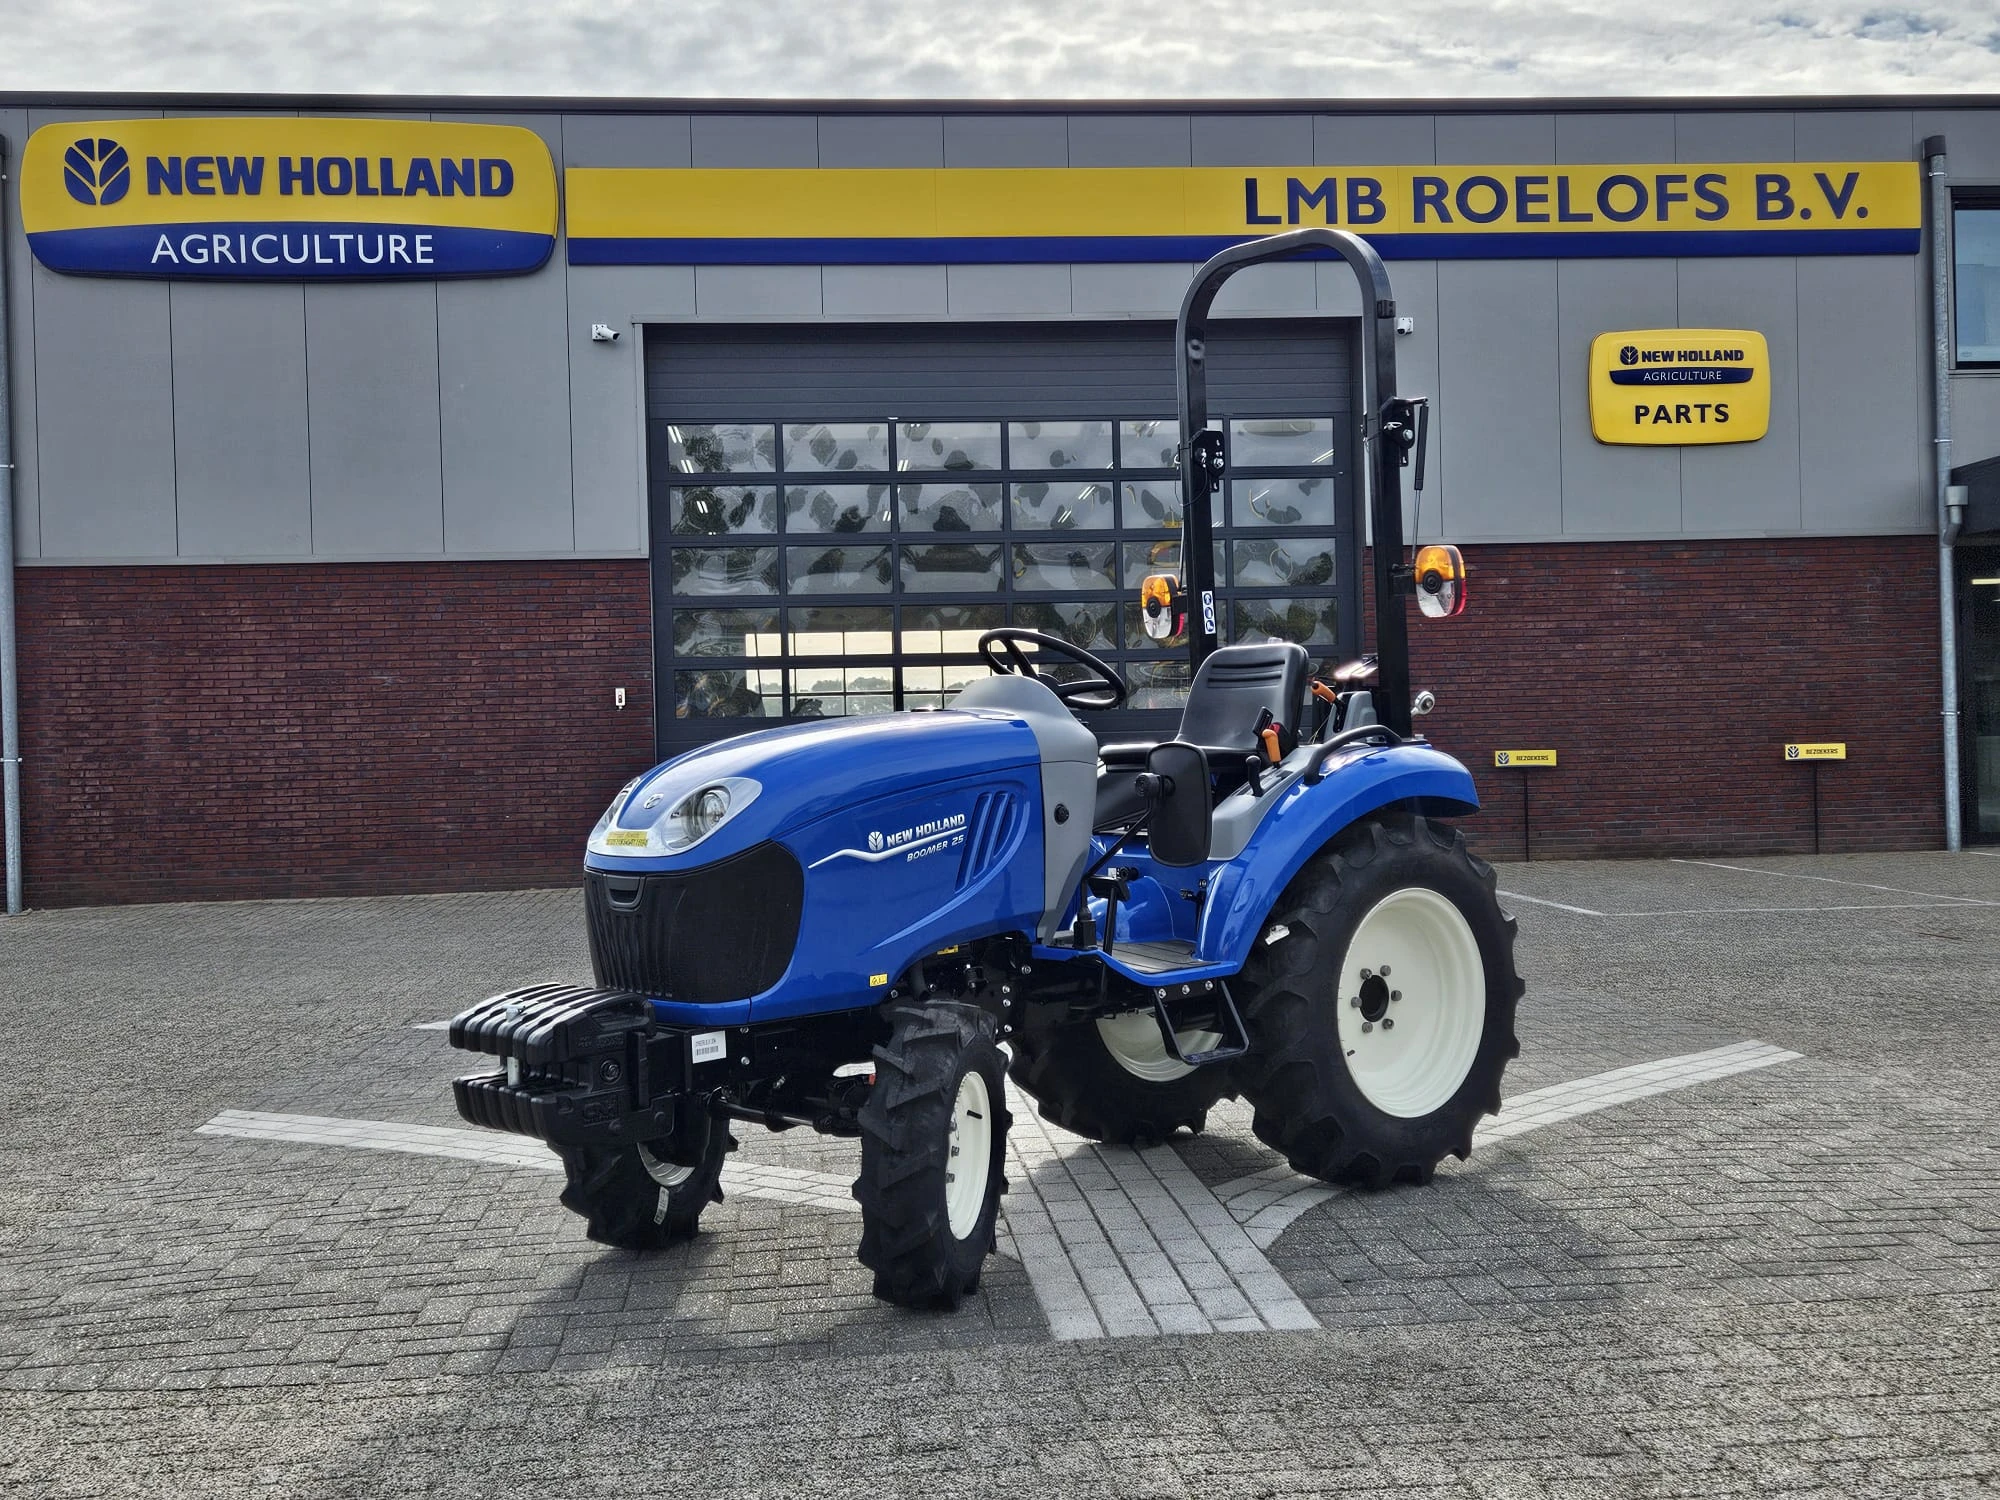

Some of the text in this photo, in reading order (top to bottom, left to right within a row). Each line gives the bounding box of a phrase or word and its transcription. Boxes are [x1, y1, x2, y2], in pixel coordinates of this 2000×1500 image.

[146, 156, 514, 197] NEW HOLLAND
[1245, 171, 1869, 226] LMB ROELOFS B.V.
[151, 233, 435, 265] AGRICULTURE
[1641, 349, 1744, 363] NEW HOLLAND
[1643, 370, 1722, 381] AGRICULTURE
[1634, 403, 1729, 425] PARTS
[886, 813, 966, 848] NEW HOLLAND
[906, 834, 965, 863] BOOMER 25
